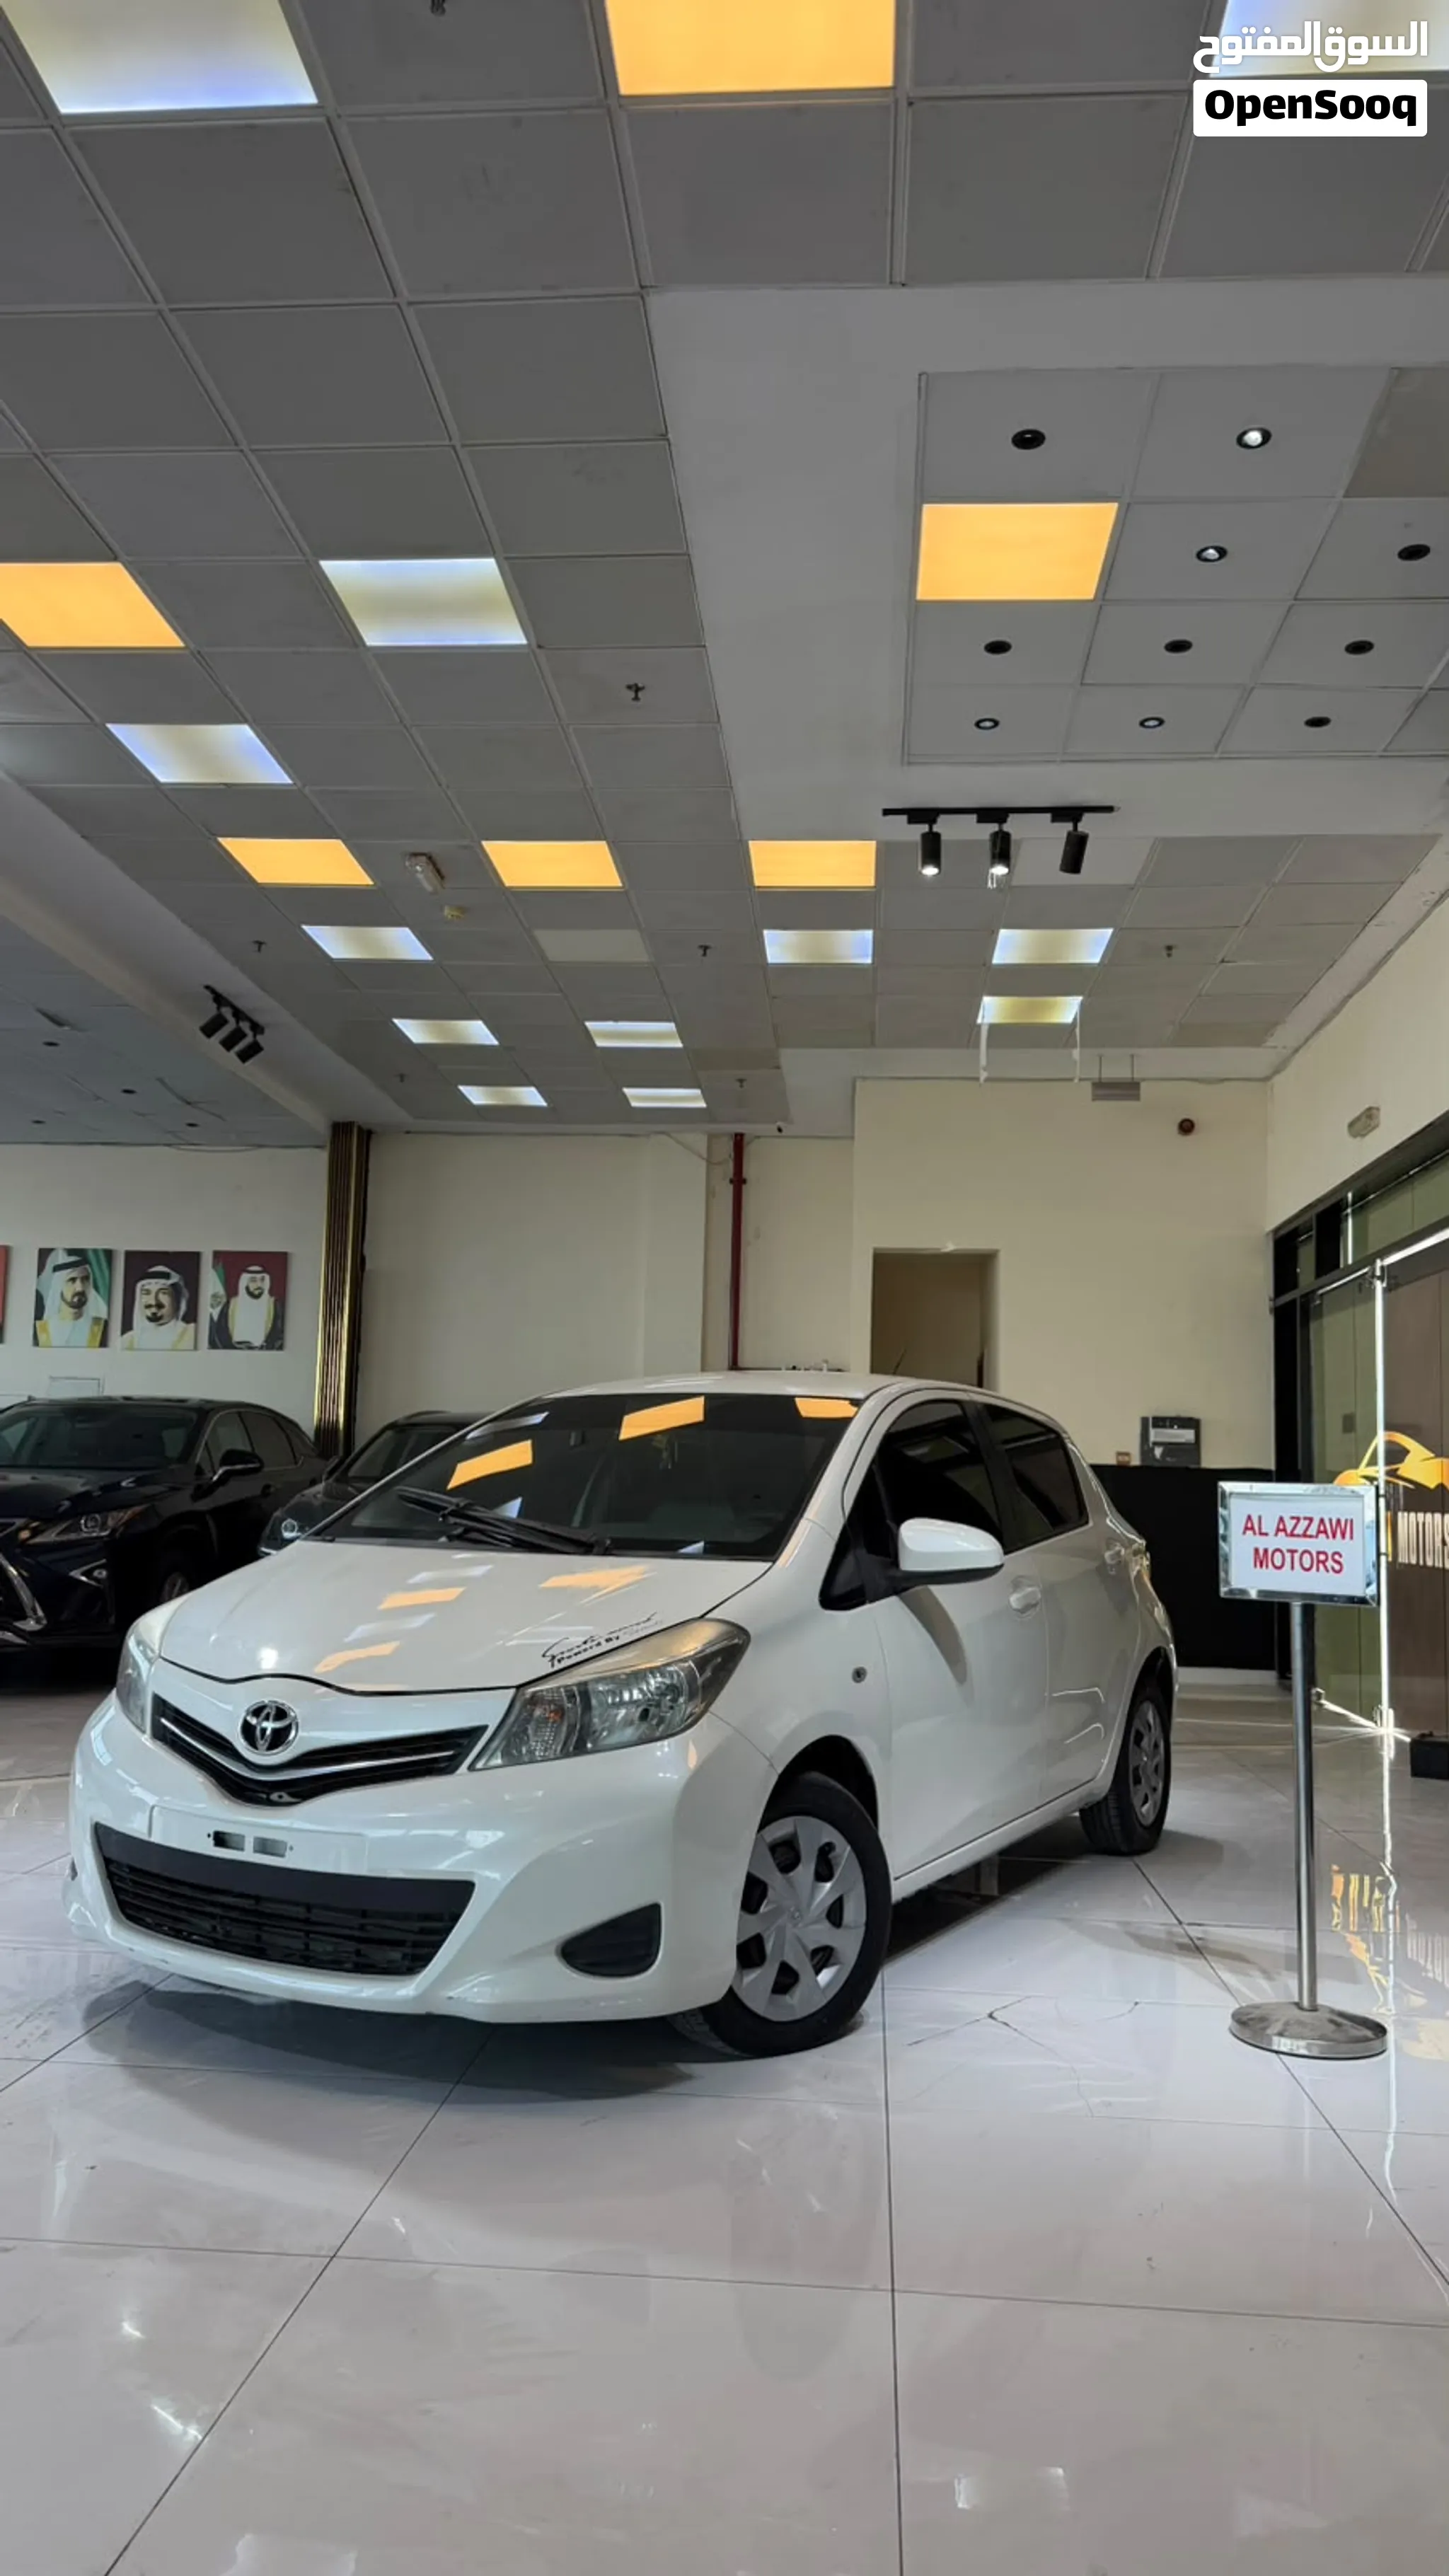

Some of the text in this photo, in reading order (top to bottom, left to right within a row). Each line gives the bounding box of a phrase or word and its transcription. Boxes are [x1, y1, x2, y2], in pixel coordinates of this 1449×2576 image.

[1242, 1513, 1354, 1540] AL AZZAWI
[1253, 1547, 1344, 1574] MOTORS
